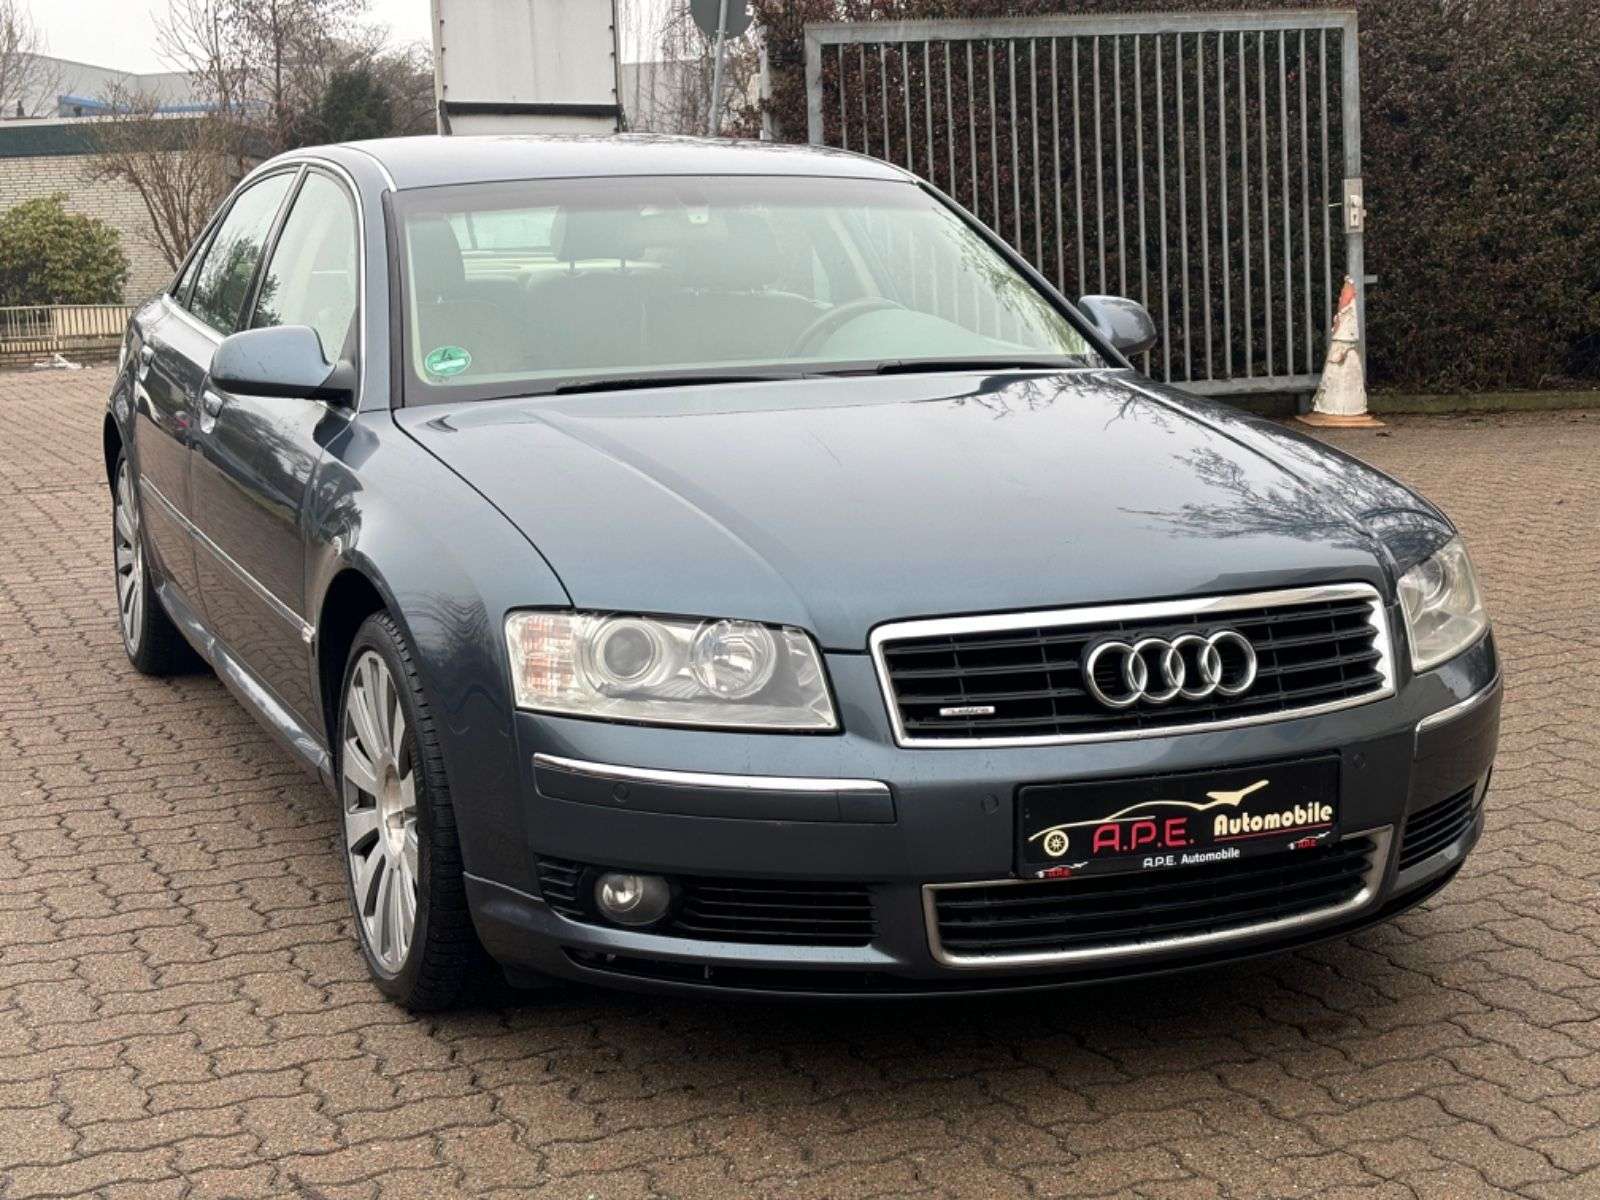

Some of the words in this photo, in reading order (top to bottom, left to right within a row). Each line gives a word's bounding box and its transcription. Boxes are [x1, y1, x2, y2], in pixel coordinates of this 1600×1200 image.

[1093, 817, 1195, 855] A.P.E.
[1214, 801, 1333, 836] Automobile
[1143, 855, 1176, 869] A.P.E.
[1181, 847, 1241, 865] Automobile
